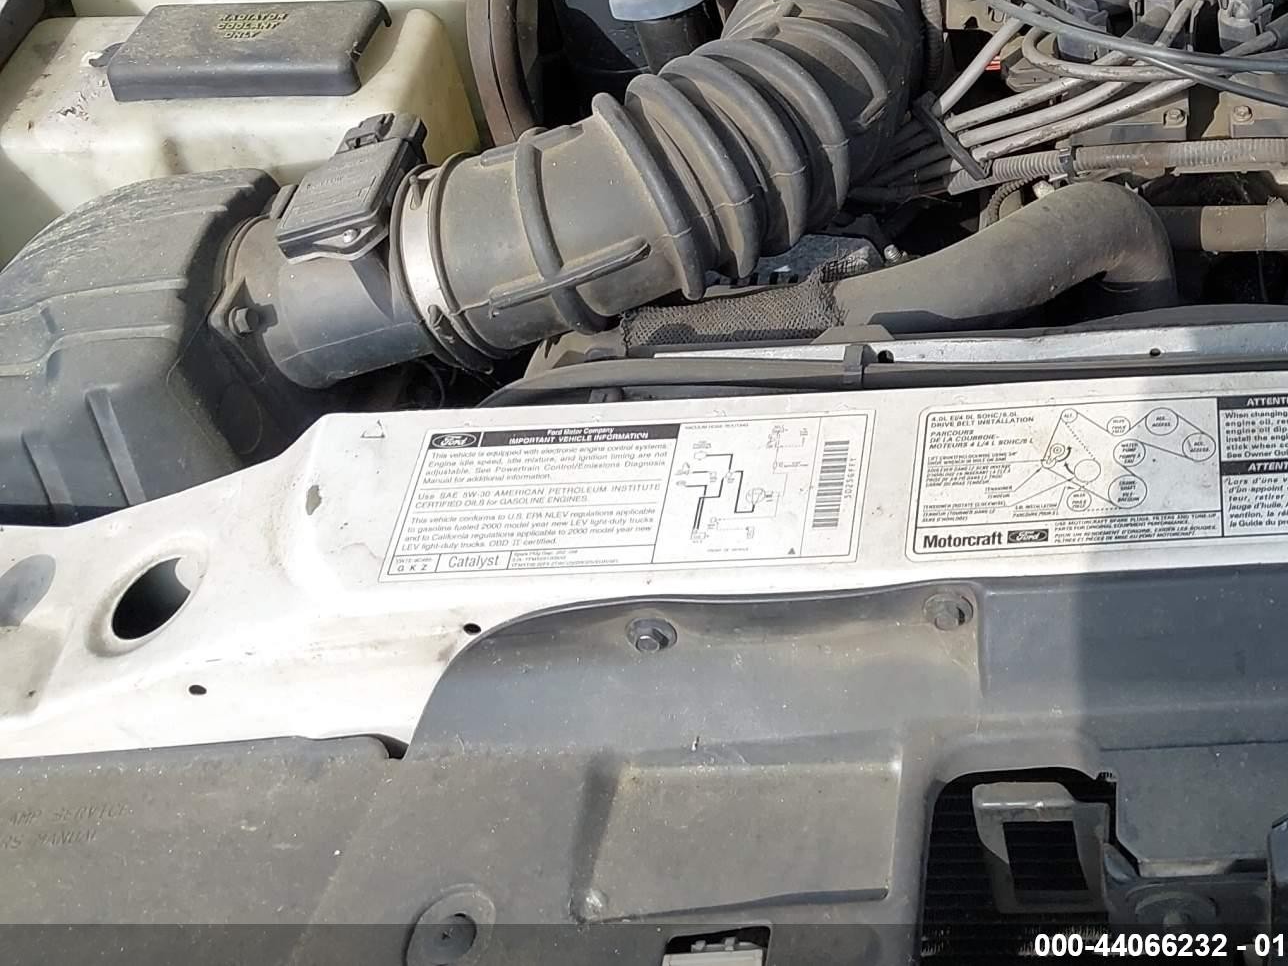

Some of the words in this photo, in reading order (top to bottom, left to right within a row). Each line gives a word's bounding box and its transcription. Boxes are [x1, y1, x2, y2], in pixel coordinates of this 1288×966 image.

[219, 12, 288, 22] RADIATOR
[216, 22, 282, 31] COOLANT
[223, 31, 260, 40] ONLY
[977, 416, 1034, 425] INSTALLATION
[930, 429, 974, 437] PARCOURS
[439, 436, 466, 446] Ford
[509, 436, 555, 445] IMPORTANT
[558, 434, 592, 442] VEHICLE
[593, 432, 649, 441] INFORMATION
[418, 492, 434, 500] Use
[439, 491, 457, 499] SAE
[462, 490, 490, 498] 5W-30
[493, 488, 544, 497] AMERICAN
[548, 486, 607, 495] PETROLEUM
[611, 483, 660, 492] INSTITUTE
[415, 500, 462, 509] CERTIFIED
[463, 499, 484, 507] OILS
[499, 497, 544, 505] GASOLINE
[922, 530, 1002, 548] Motorcraft
[448, 554, 500, 571] Catalyst
